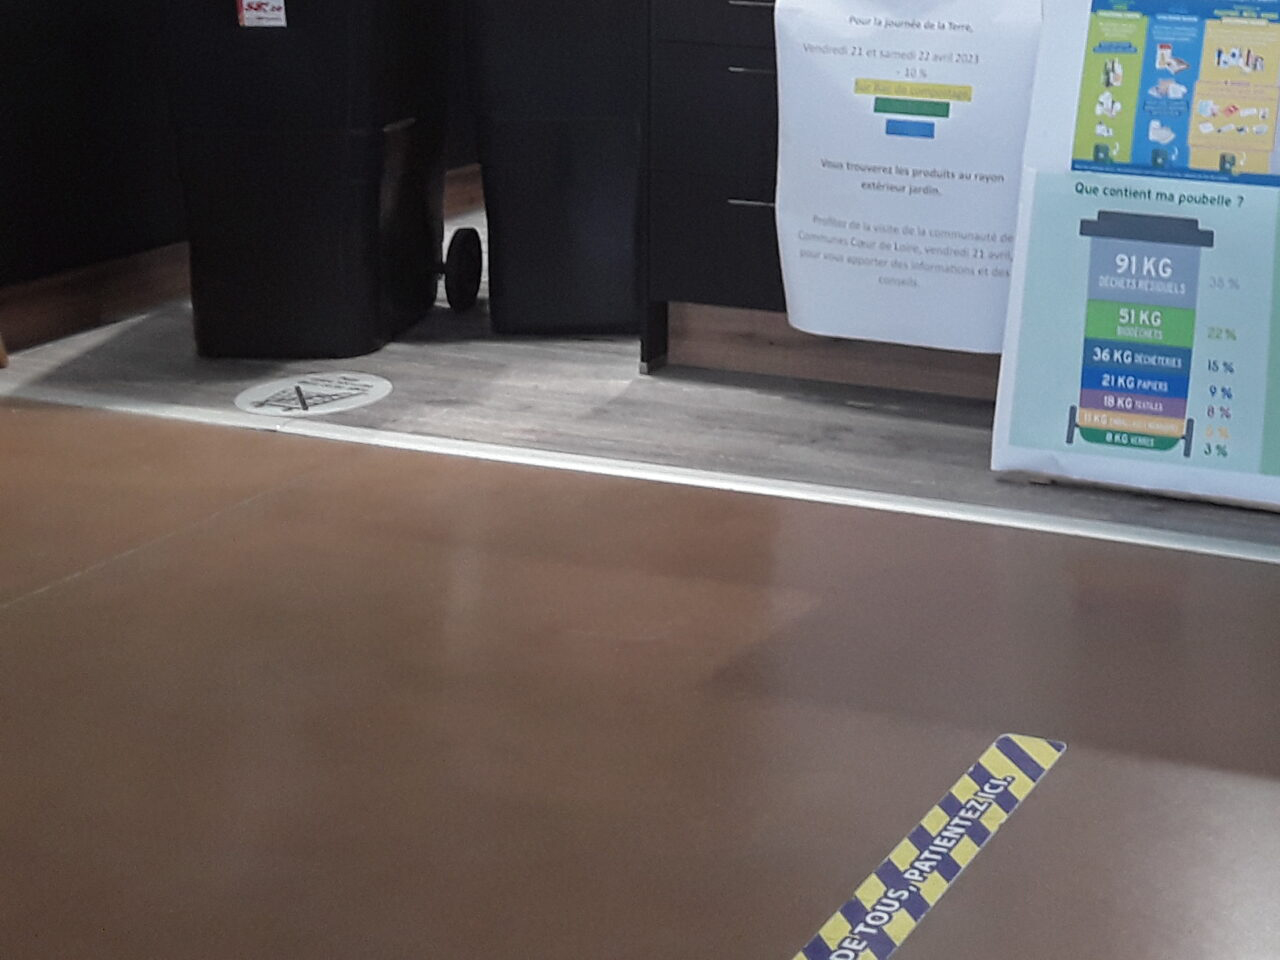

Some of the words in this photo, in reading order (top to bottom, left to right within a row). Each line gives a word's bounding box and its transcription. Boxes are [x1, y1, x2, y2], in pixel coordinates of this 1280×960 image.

[850, 16, 871, 26] Pour
[874, 17, 882, 27] la
[884, 18, 921, 29] journée
[924, 20, 935, 30] de
[937, 20, 946, 30] la
[949, 21, 974, 34] Terre,
[803, 42, 848, 56] Vendredi
[850, 46, 863, 57] 21
[867, 47, 877, 57] et
[880, 48, 915, 61] samedi
[919, 51, 931, 61] 22
[933, 51, 951, 62] avril
[955, 53, 980, 65] 2023
[820, 158, 844, 169] Vous
[846, 161, 893, 175] trouverez
[895, 164, 910, 176] les
[912, 166, 955, 180] produits
[959, 172, 972, 180] au
[974, 173, 1004, 184] rayon
[861, 180, 906, 193] extérieur
[908, 184, 942, 196] jardin.
[1074, 182, 1099, 198] Que
[1102, 185, 1152, 203] contient
[1156, 192, 1175, 203] ma
[1178, 190, 1232, 207] poubelle
[1237, 195, 1244, 207] ?
[850, 220, 862, 231] de
[864, 222, 871, 231] la
[873, 222, 899, 234] visite
[902, 225, 914, 236] de
[917, 226, 926, 237] la
[929, 227, 998, 242] communauté
[1001, 233, 1014, 242] de
[879, 240, 892, 251] de
[894, 243, 922, 255] Loire,
[925, 245, 969, 258] vendredi
[972, 248, 985, 259] 21
[988, 250, 1014, 263] avril,
[847, 254, 887, 269] apporter
[891, 259, 909, 271] des
[911, 260, 974, 276] informations
[977, 266, 988, 276] et
[992, 267, 1010, 278] des
[1115, 254, 1136, 275] 91
[1143, 256, 1172, 278] KG
[1119, 308, 1135, 324] 51
[1140, 310, 1161, 326] KG
[1093, 347, 1111, 361] 36
[1113, 350, 1132, 364] KG
[1208, 359, 1219, 371] 15
[1223, 362, 1234, 374] %
[1102, 374, 1114, 387] 21
[1118, 376, 1135, 389] KG
[1136, 379, 1168, 392] PAPIERS
[1210, 386, 1217, 397] 9
[1221, 387, 1233, 399] %
[1104, 396, 1114, 407] 18
[1117, 397, 1132, 409] KG
[1094, 414, 1108, 425] KG
[1220, 407, 1231, 419] %
[1115, 434, 1128, 444] KG
[1204, 443, 1212, 455] 3
[1216, 445, 1228, 457] %
[828, 932, 867, 960] DE
[977, 775, 1015, 802] ICI.
